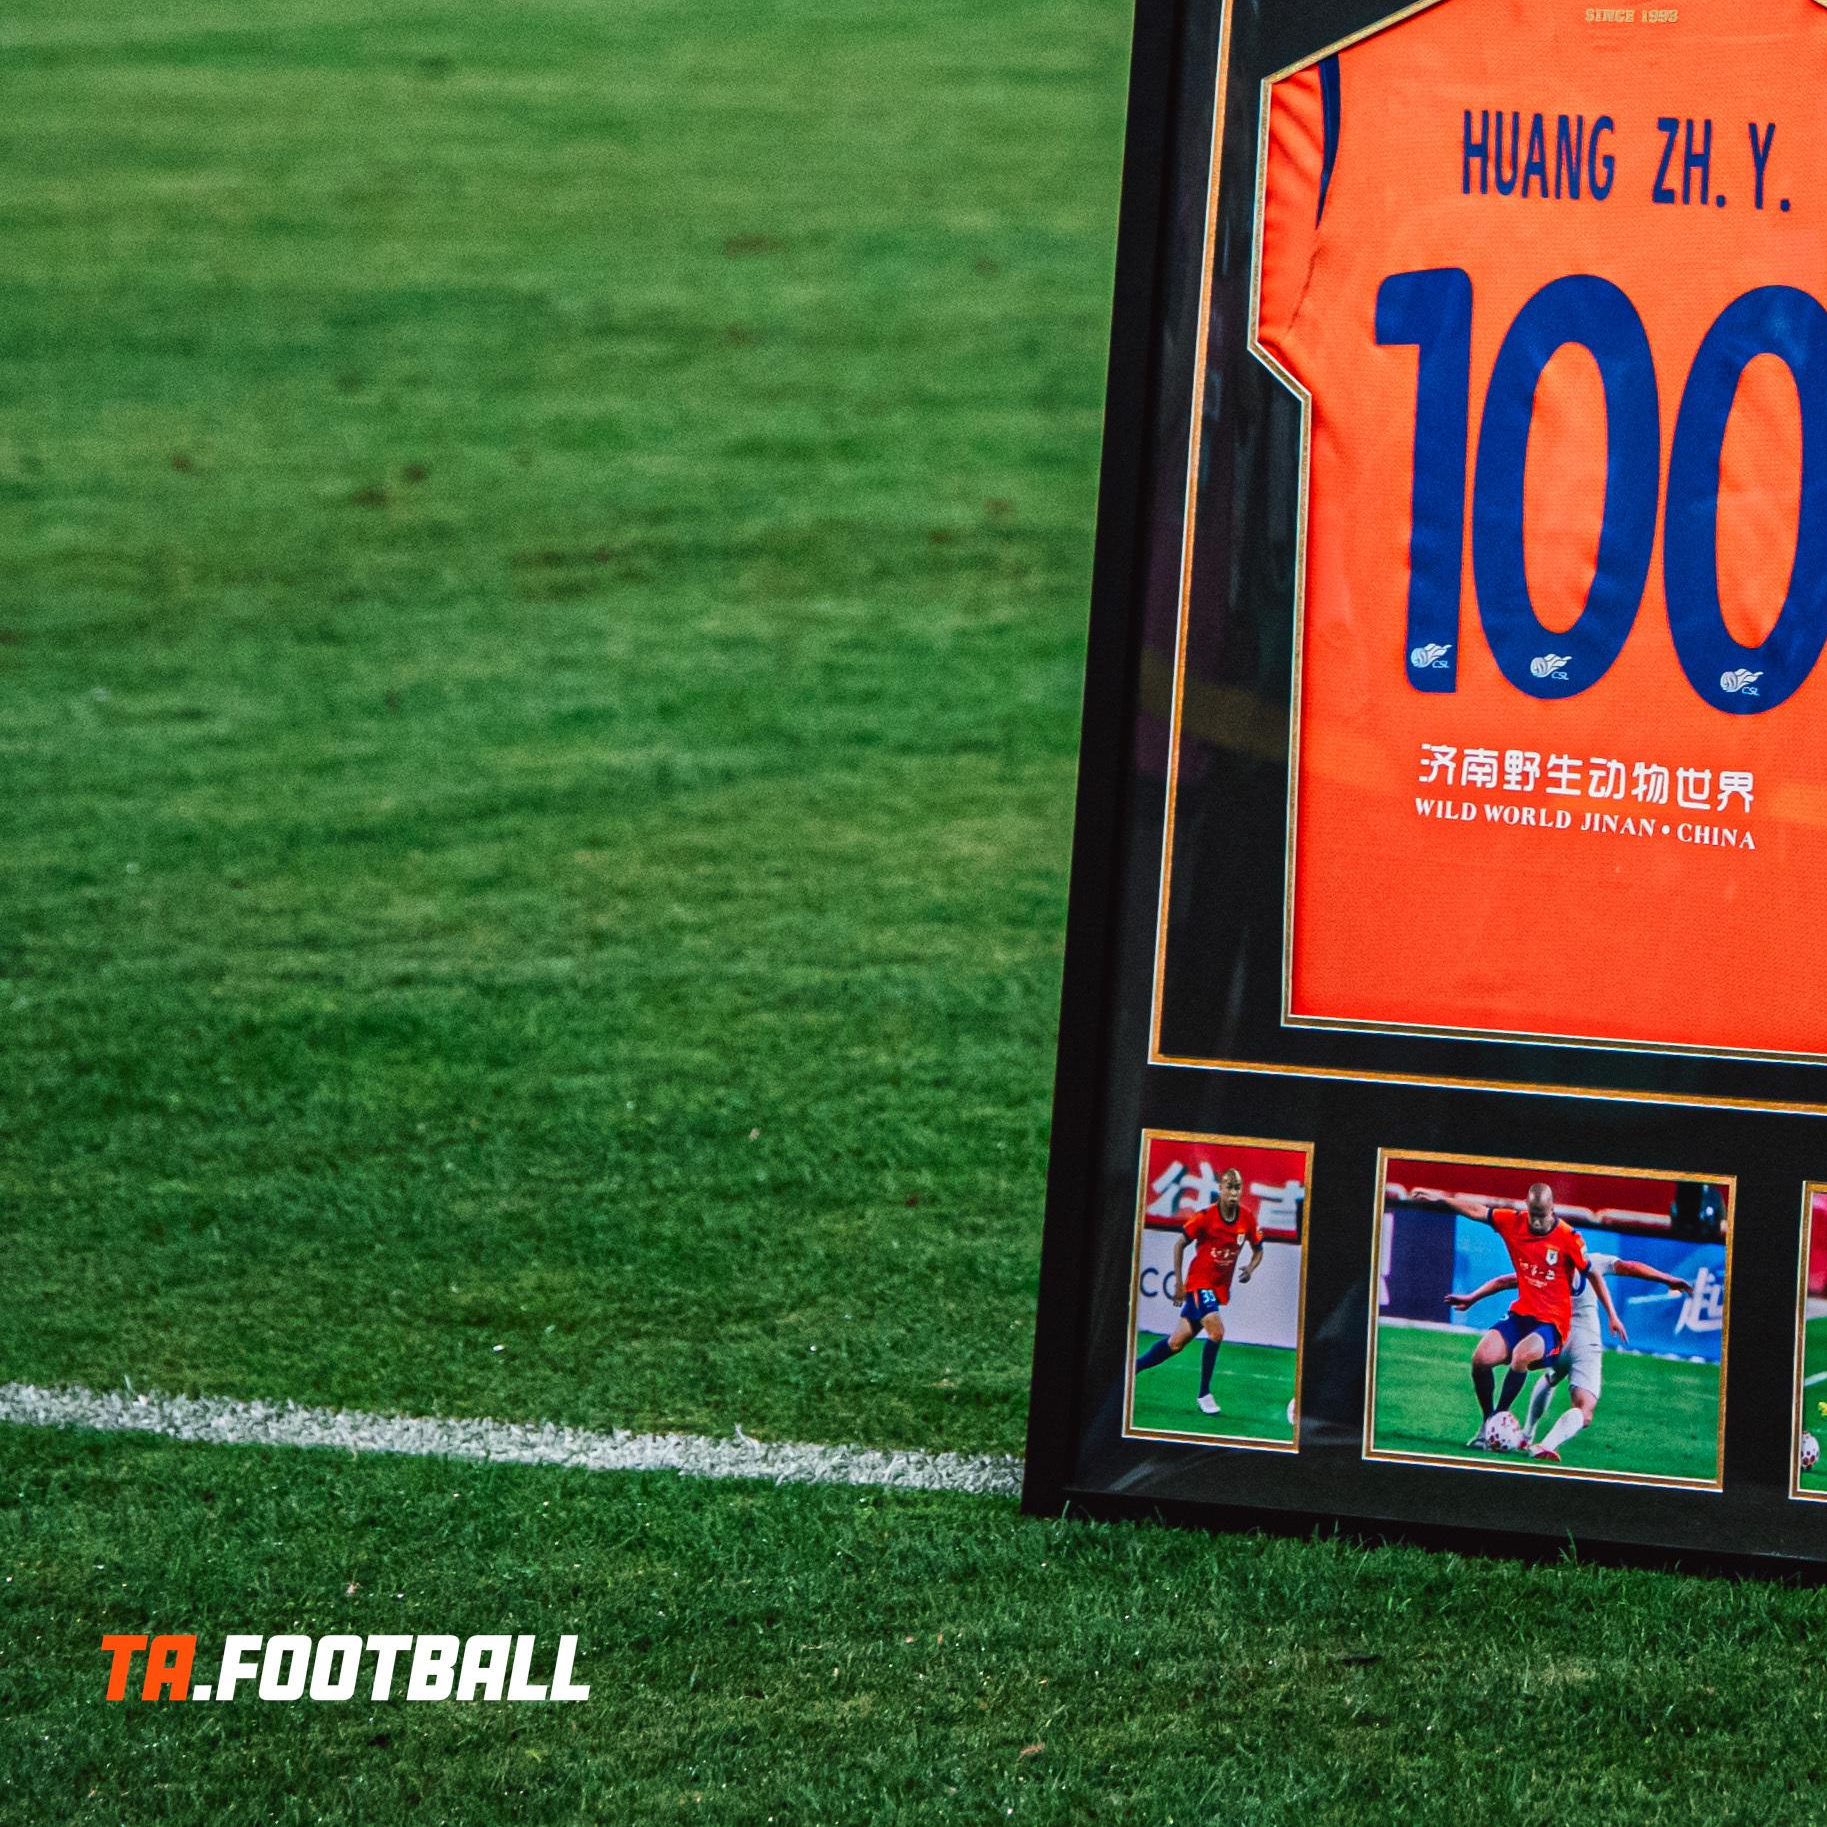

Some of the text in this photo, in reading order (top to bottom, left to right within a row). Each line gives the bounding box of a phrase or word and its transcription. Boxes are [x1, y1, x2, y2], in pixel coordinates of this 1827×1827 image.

[1585, 8, 1635, 23] SINCE
[1462, 109, 1791, 213] HUANG ZH. Y.
[1418, 742, 1756, 814] 济南野生动物世界
[1414, 797, 1757, 850] WILD WORLD JINAN CHINA
